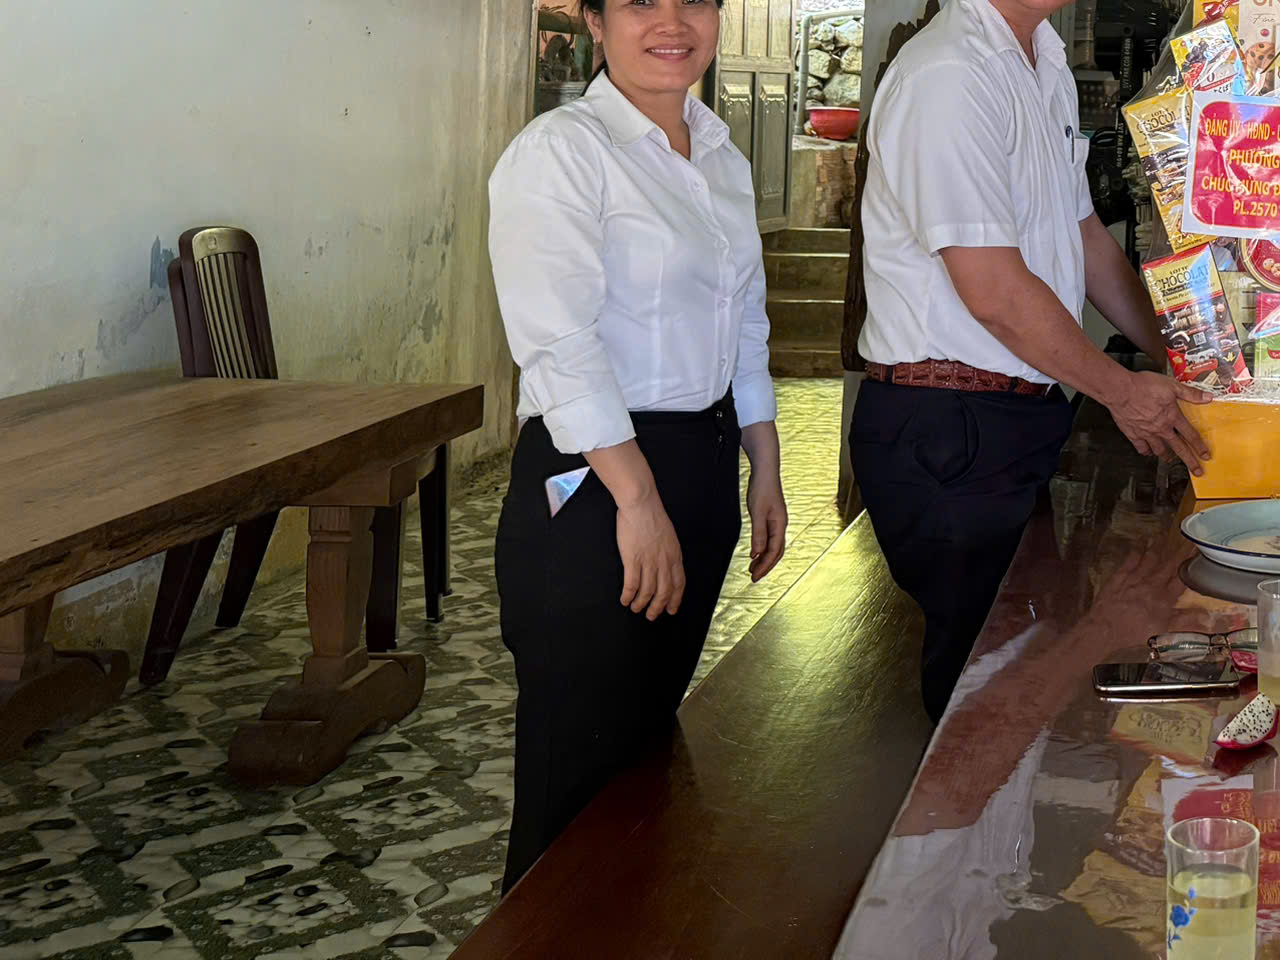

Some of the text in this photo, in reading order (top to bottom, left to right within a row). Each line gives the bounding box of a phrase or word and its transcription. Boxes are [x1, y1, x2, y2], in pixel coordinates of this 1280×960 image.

[1205, 113, 1228, 137] ĐẢNG
[1247, 122, 1270, 141] HĐND
[1232, 199, 1278, 218] PL.2570
